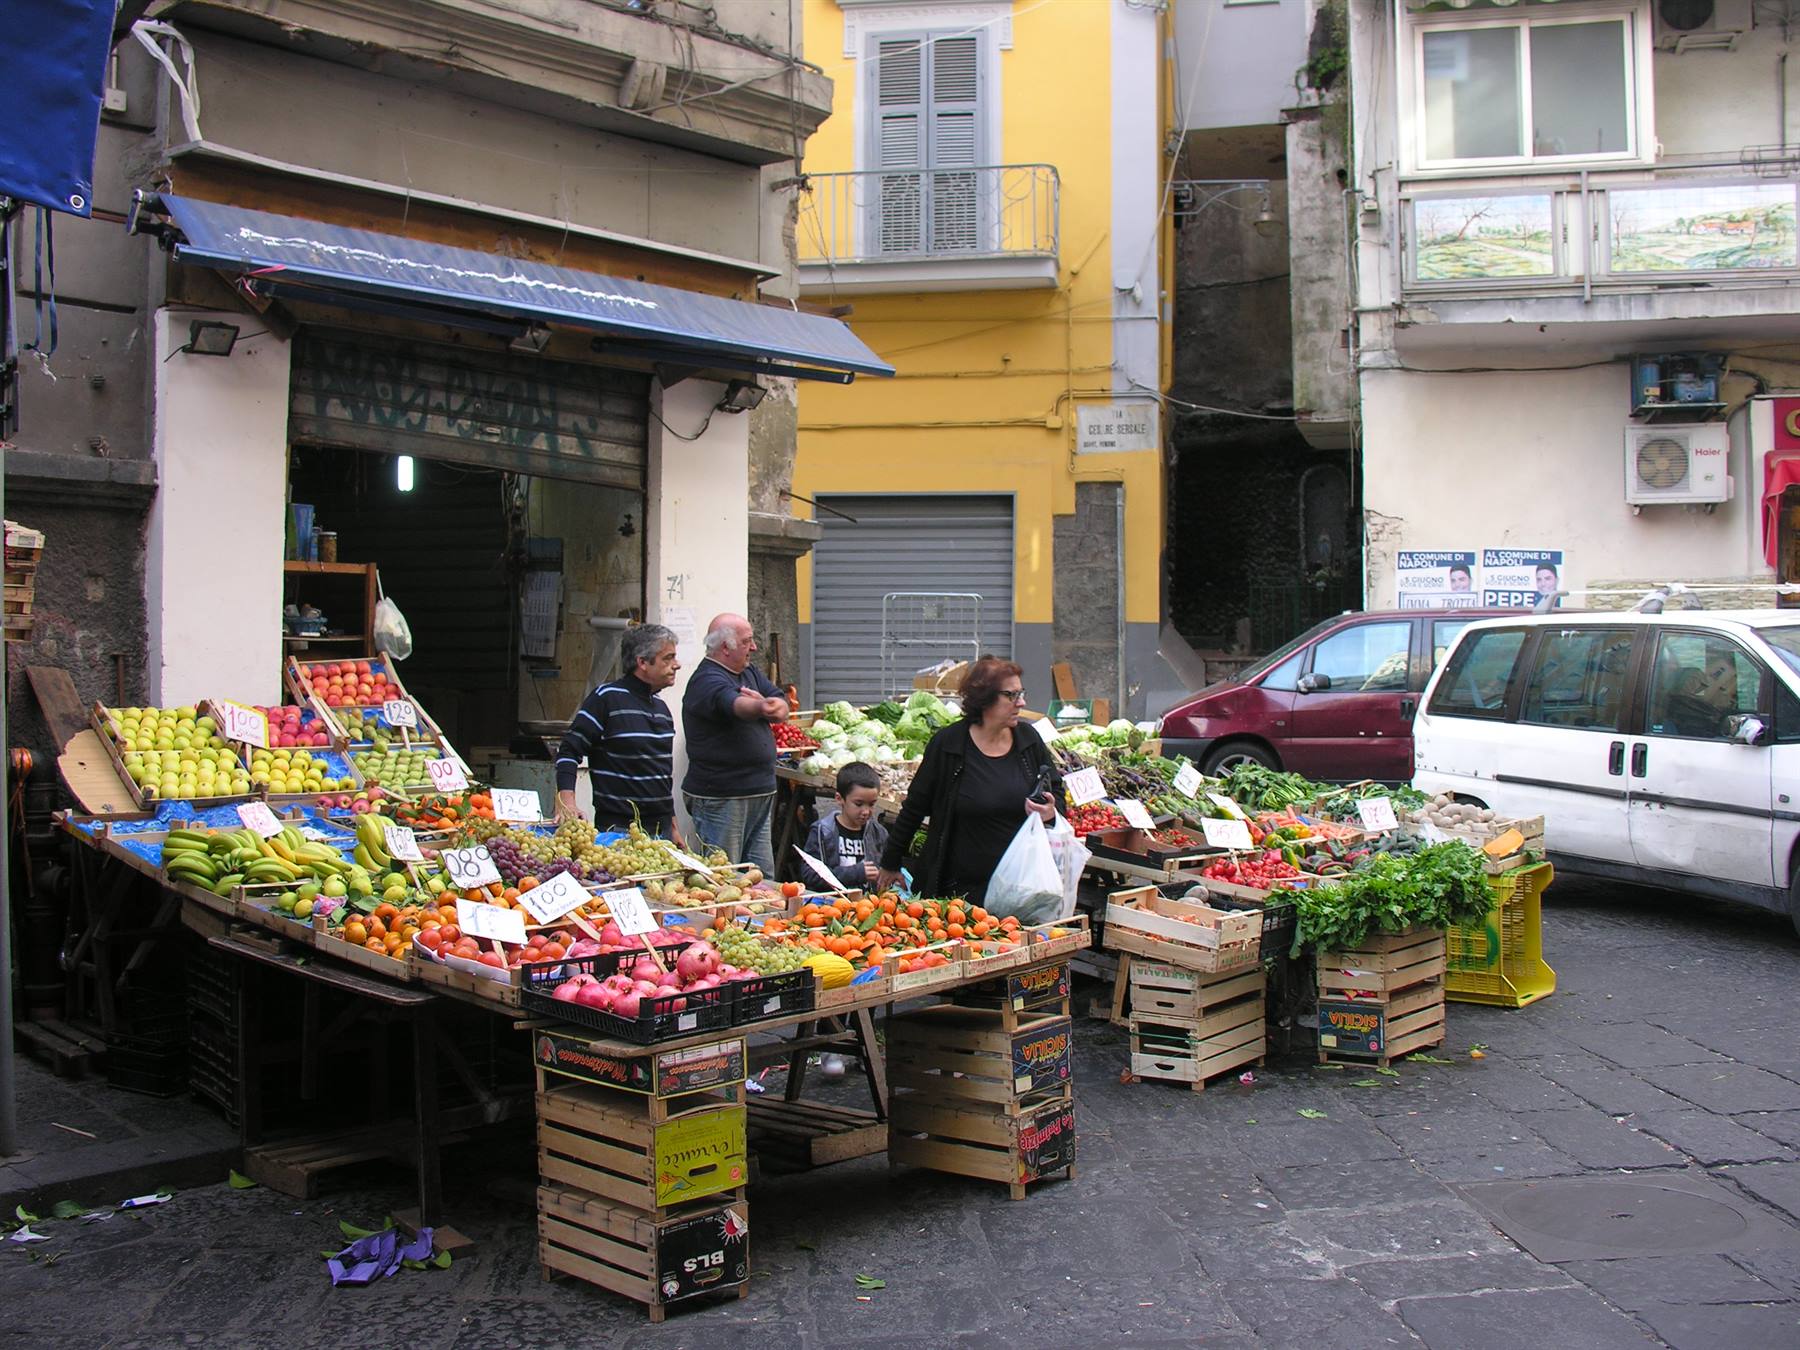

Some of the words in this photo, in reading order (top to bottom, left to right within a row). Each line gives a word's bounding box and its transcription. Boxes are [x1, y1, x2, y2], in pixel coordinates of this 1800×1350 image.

[1695, 448, 1721, 456] Haier
[1399, 560, 1437, 568] NAPOLI
[1412, 553, 1453, 561] COMUNE
[1454, 553, 1465, 561] DI
[1498, 551, 1540, 560] COMUNE
[1541, 552, 1552, 560] DI
[1411, 576, 1444, 584] GIUGNO
[1485, 592, 1535, 608] PEPE
[228, 706, 259, 732] 100
[529, 883, 567, 916] 100
[1021, 967, 1060, 988] SICILIA
[1328, 1011, 1378, 1028] SICILIA
[1022, 1033, 1066, 1060] SICILIA
[1061, 1113, 1073, 1130] Le
[1020, 1117, 1062, 1150] Primizie
[683, 1249, 724, 1272] BLS
